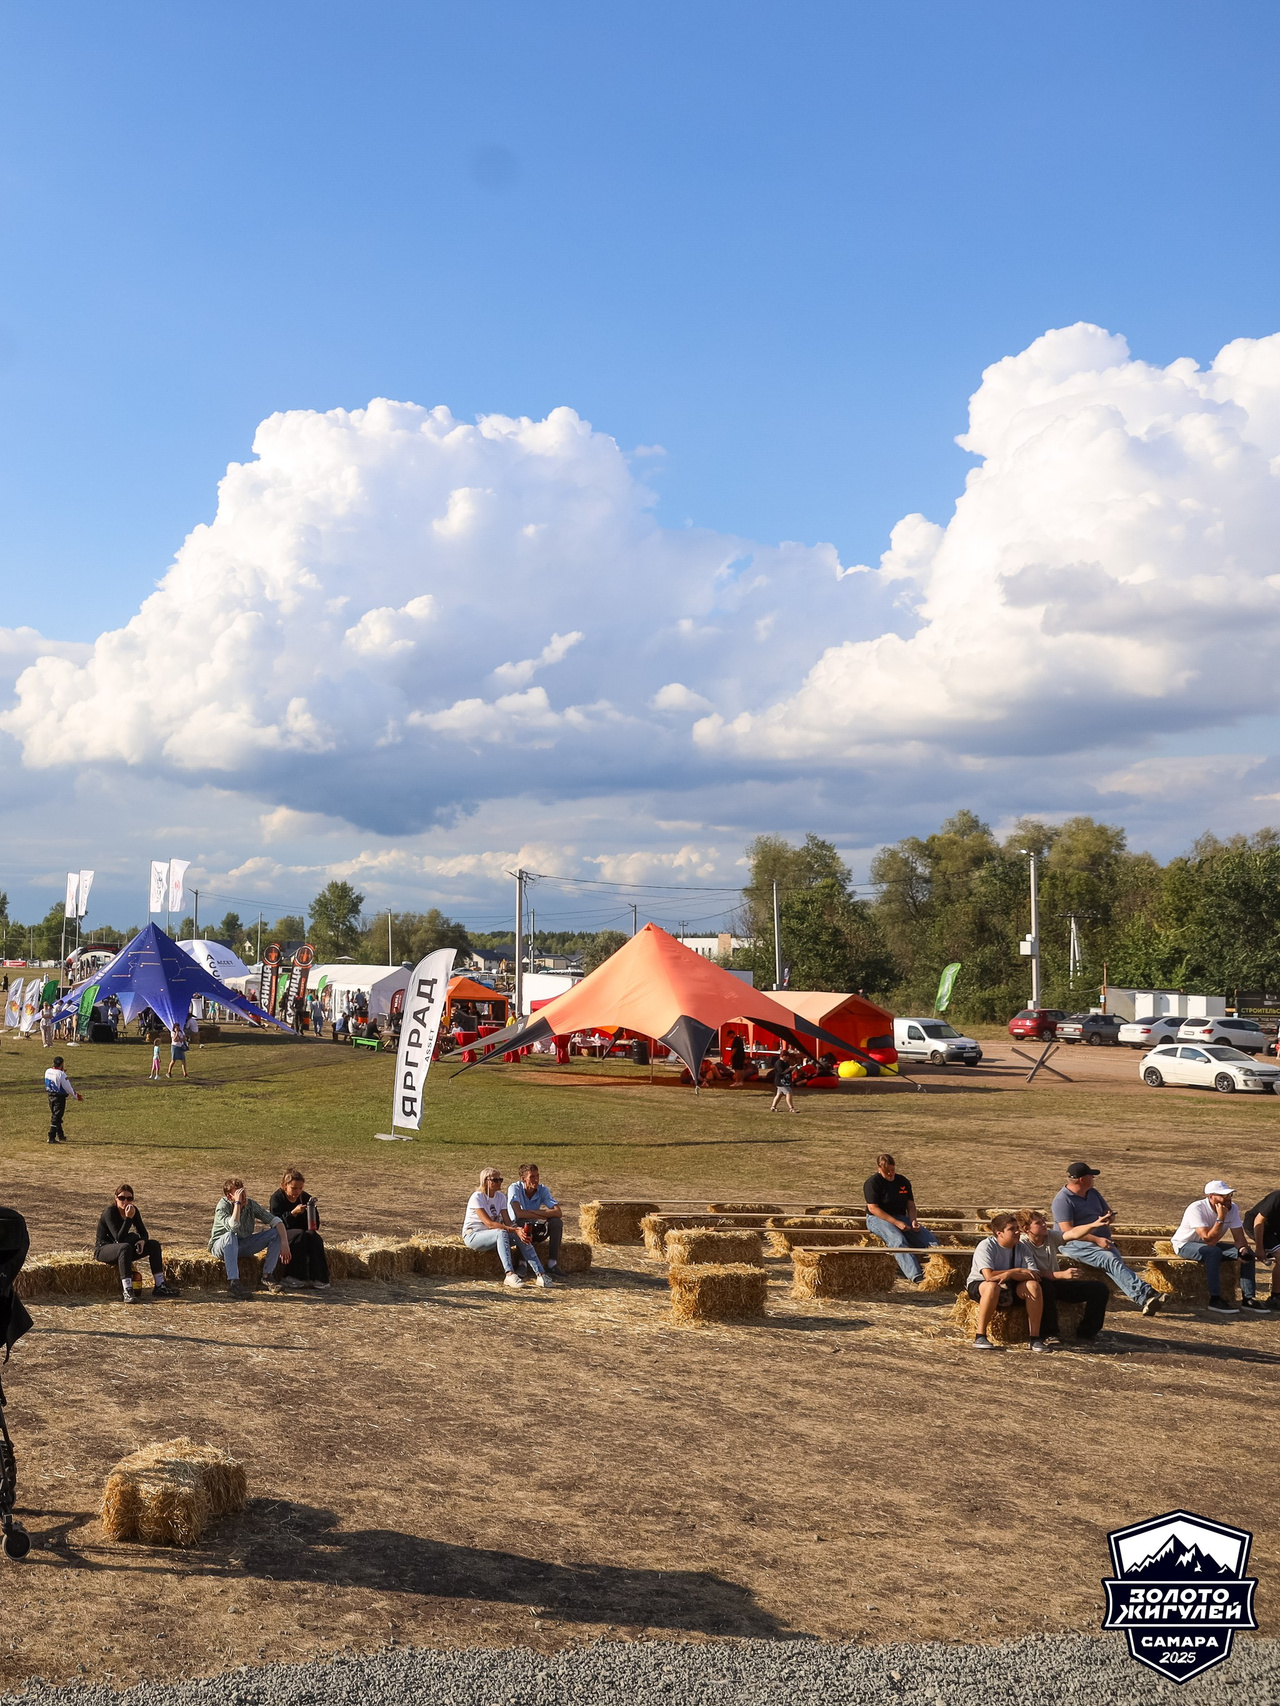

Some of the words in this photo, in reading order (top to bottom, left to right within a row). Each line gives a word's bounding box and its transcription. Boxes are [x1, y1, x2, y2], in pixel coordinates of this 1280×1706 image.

[261, 965, 272, 1013] УЗНИЦА
[402, 978, 438, 1118] ЯРГРАД
[425, 1030, 435, 1063] ASSET
